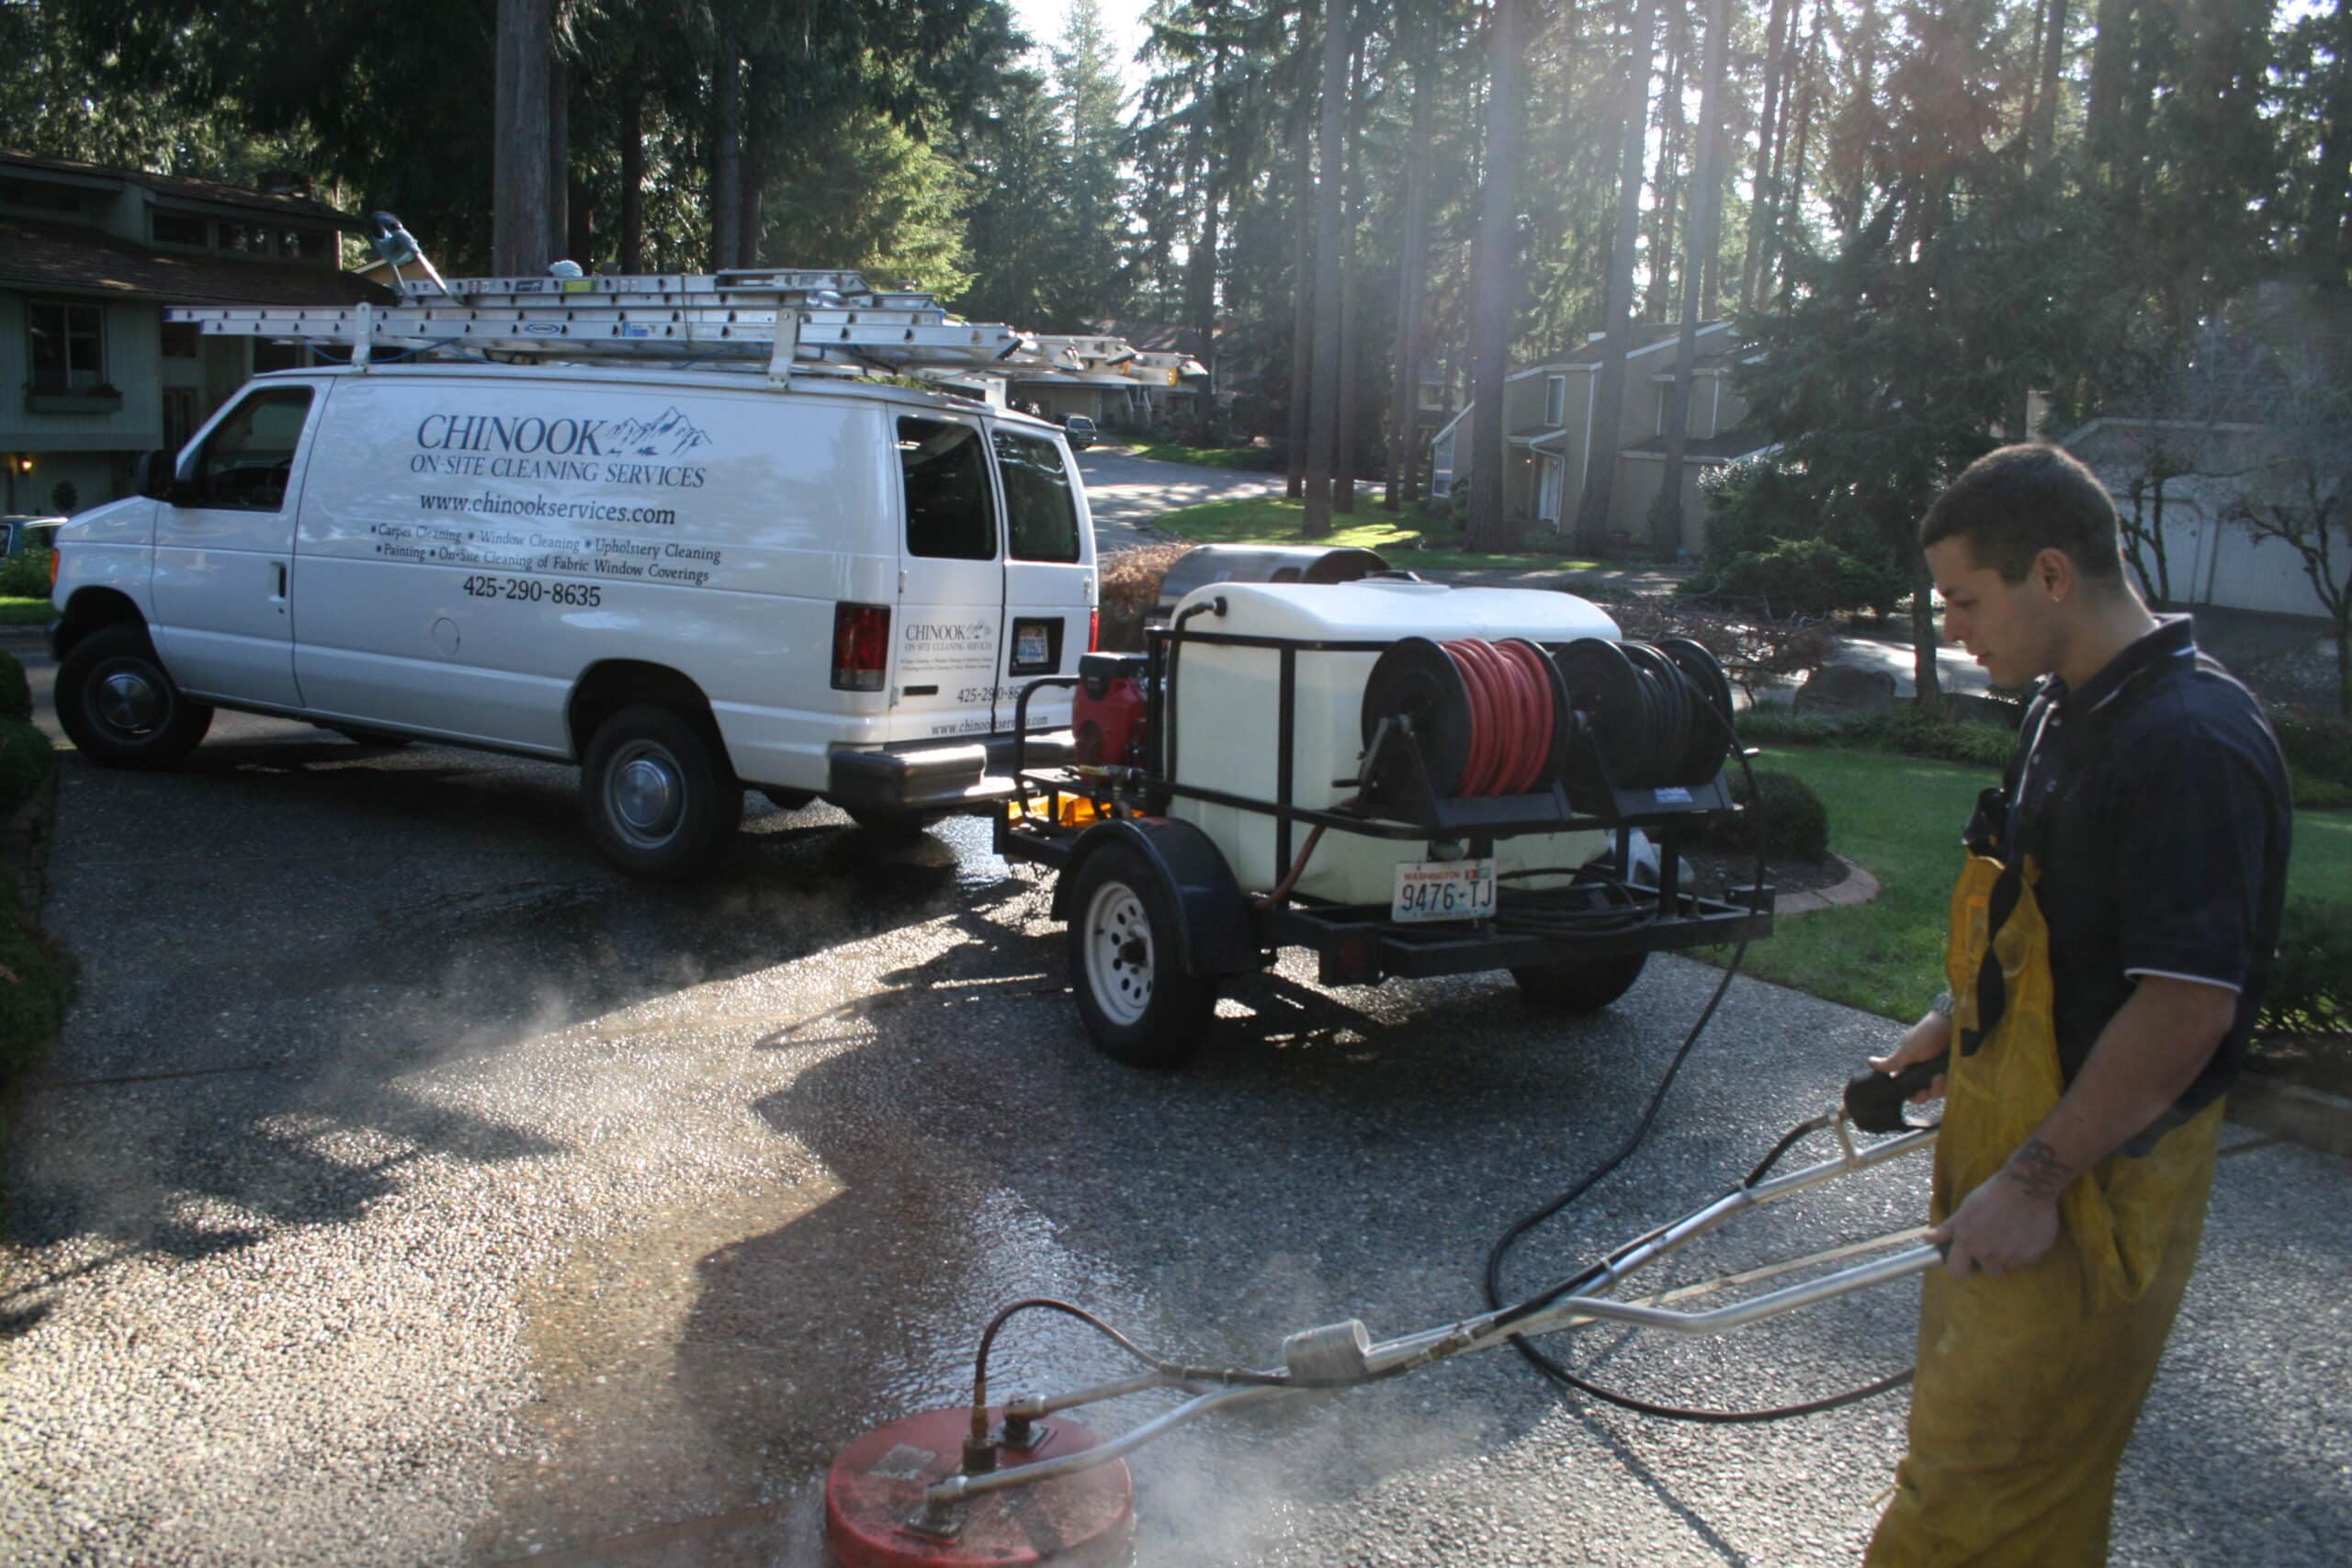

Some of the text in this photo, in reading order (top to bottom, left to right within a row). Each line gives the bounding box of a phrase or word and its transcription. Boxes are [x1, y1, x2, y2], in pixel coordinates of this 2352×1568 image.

[417, 414, 607, 457] CHINOOK
[411, 454, 707, 489] ON-SITE CLEANING SERVICES
[420, 491, 676, 525] www.chinookservices.com
[378, 523, 721, 565] Carpet Cleaning Window Cleaning Upholstery Cleaning
[384, 543, 710, 586] Painting On-Site Cleaning of Fabric Window Coverings
[463, 575, 603, 607] 425-290-8635
[905, 624, 966, 641] CHINOOK
[1401, 879, 1493, 912] 9476-TJ
